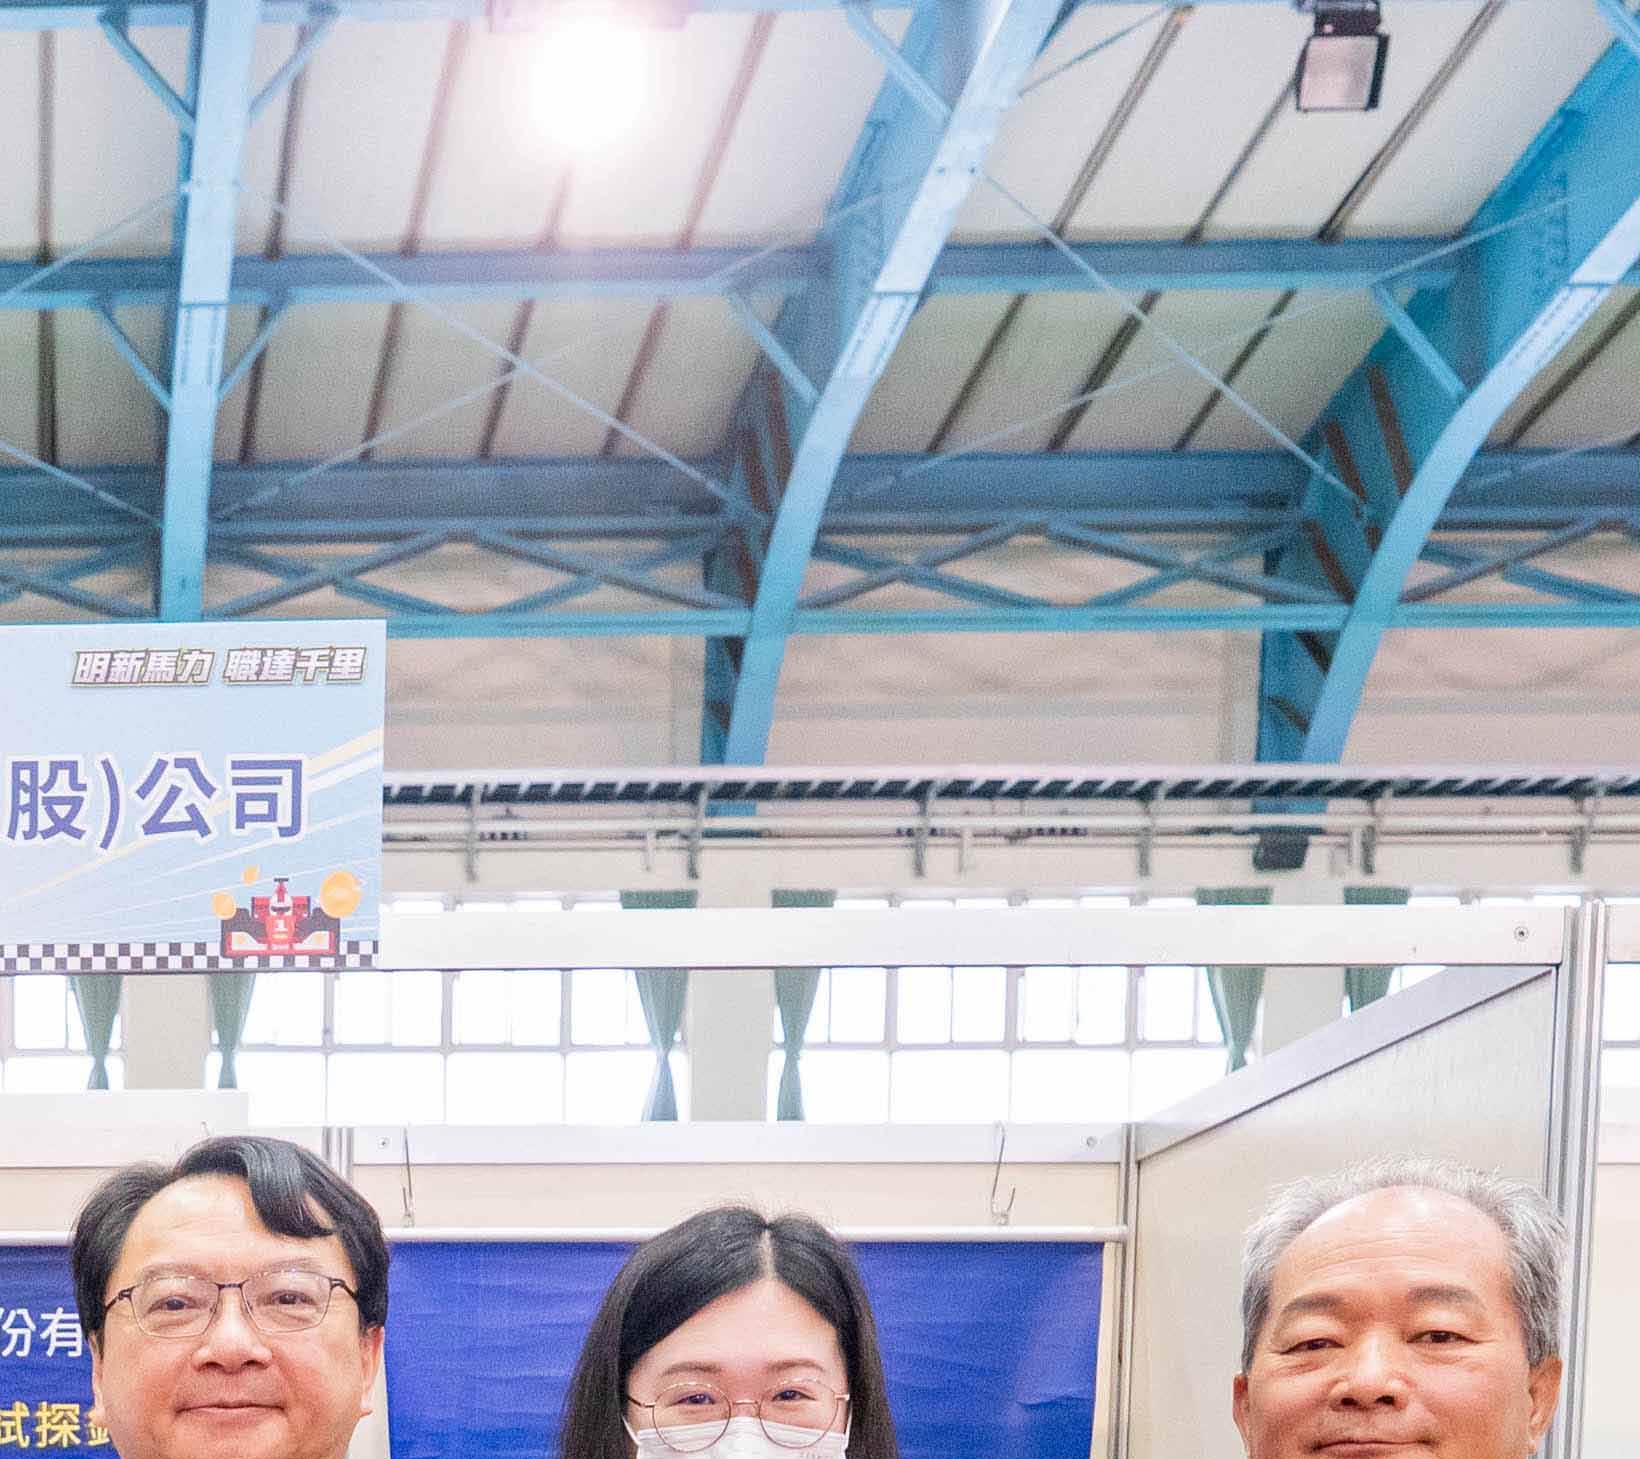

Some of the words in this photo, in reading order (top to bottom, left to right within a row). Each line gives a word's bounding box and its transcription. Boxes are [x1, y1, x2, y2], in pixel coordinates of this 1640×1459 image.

[71, 649, 215, 686] 明新馬力
[223, 646, 367, 685] 職達千里
